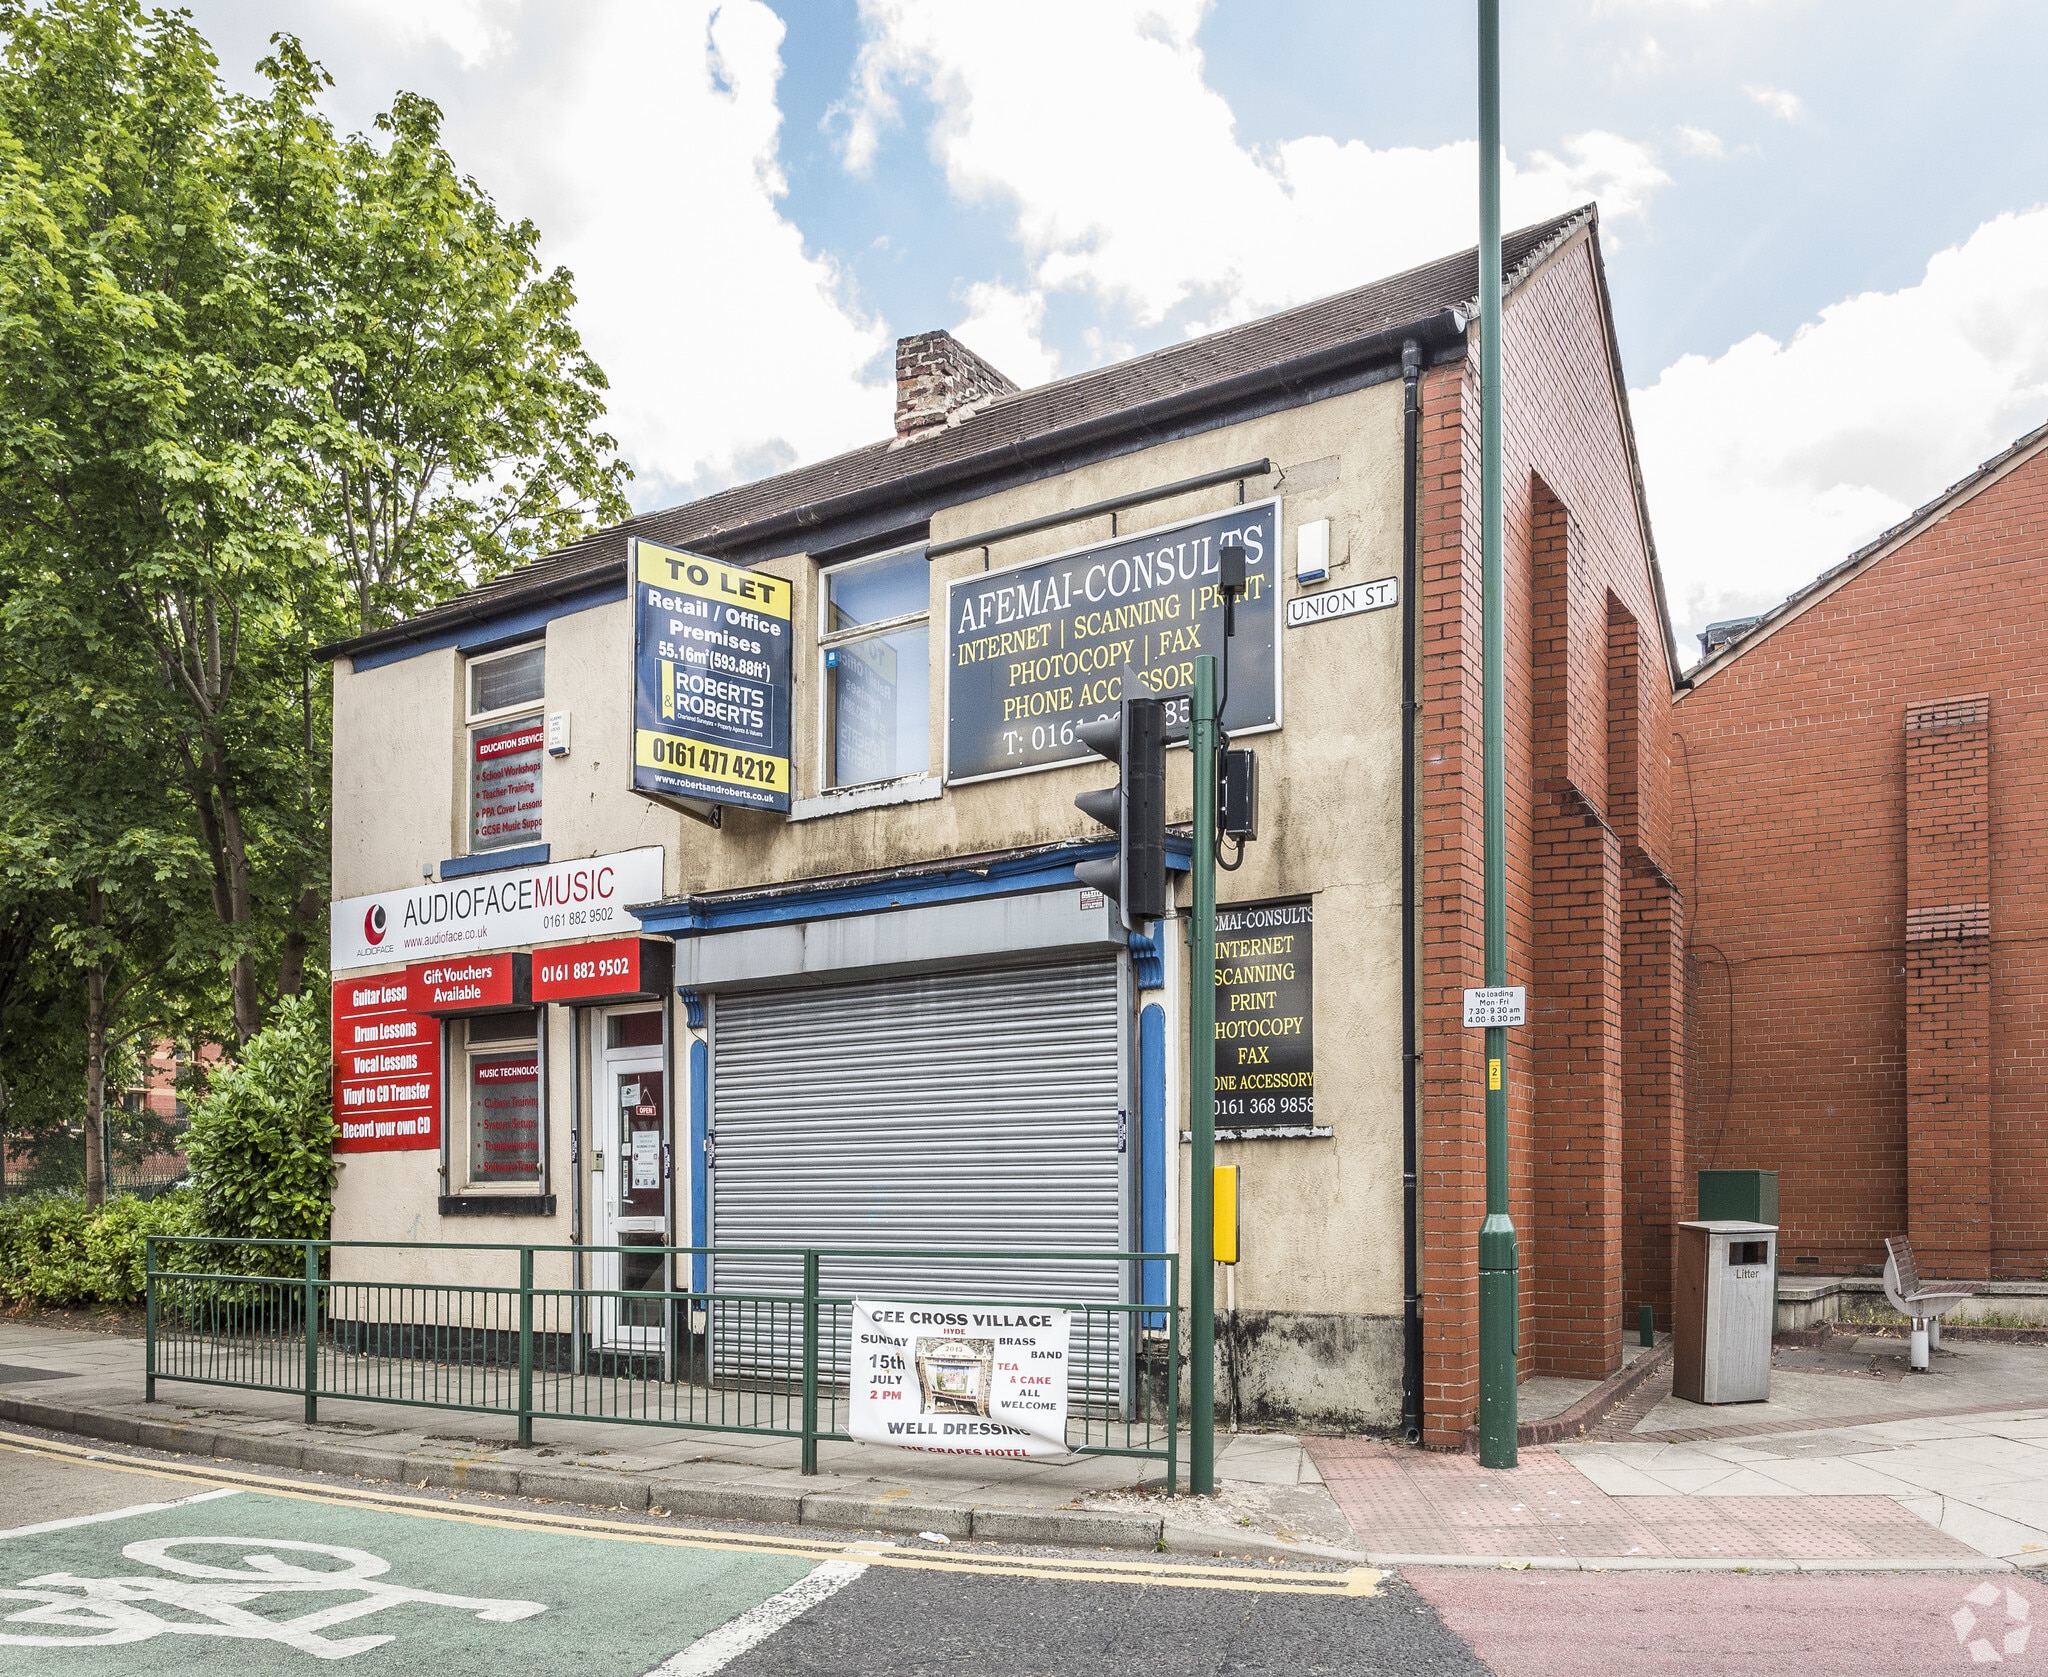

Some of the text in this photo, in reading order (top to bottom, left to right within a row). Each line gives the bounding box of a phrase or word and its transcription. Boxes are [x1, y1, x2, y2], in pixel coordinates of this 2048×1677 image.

[665, 557, 775, 604] TO LET
[648, 589, 708, 618] Retail
[725, 608, 781, 636] Office
[1292, 591, 1356, 621] UNION
[669, 618, 762, 655] Premises
[957, 622, 1052, 666] INTERNET
[1074, 593, 1181, 640] SCANNING
[1009, 639, 1135, 687] PHOTOCOPY
[1159, 623, 1202, 656] FAX
[676, 671, 764, 708] ROBERTS
[664, 692, 764, 729] & ROBERTS
[1003, 686, 1074, 721] PHONE
[479, 738, 517, 755] EDUCATION
[1003, 729, 1024, 755] T:
[653, 738, 776, 784] 0161 477 4212
[481, 762, 541, 781] School Workshops
[481, 782, 535, 800] Teacher Training
[654, 774, 774, 803] www.robertsandroberts.co.uk
[481, 799, 542, 818] PPA Cover Lessons
[481, 818, 542, 836] GCSE Music Suppo
[543, 906, 613, 929] 0161 882 9502
[403, 926, 488, 949] www.audioface.co.uk
[356, 944, 394, 957] AUDIOFACE
[1215, 935, 1295, 960] INTERNET
[423, 964, 492, 985] Gift Vouchers
[541, 957, 629, 983] 0161 882 9502
[1215, 962, 1296, 987] SCANNING
[352, 985, 407, 1007] Guitar Lesso
[433, 985, 481, 1003] Available
[1230, 991, 1277, 1012] PRINT
[1486, 990, 1514, 998] loading
[1215, 1017, 1304, 1039] HOTOCOPY
[1509, 1015, 1521, 1023] pm
[354, 1021, 417, 1043] Drum Lessons
[353, 1053, 418, 1074] Vocal Lessons
[1237, 1046, 1270, 1065] FAX
[479, 1065, 538, 1078] MUSIC TECHNOLOG
[1492, 1067, 1498, 1077] 2
[1215, 1072, 1314, 1091] ONE ACCESSORY
[343, 1082, 430, 1107] Vinyl to CD Transfer
[1215, 1097, 1314, 1115] 0161 368 9858
[342, 1116, 431, 1139] Record your own CD
[484, 1118, 537, 1133] System Setups
[484, 1161, 515, 1173] Software
[1735, 1268, 1760, 1280] Litter
[871, 1310, 1052, 1327] GEE CROSS VILLAGE
[860, 1333, 909, 1347] SUNDAY
[999, 1337, 1036, 1346] BRASS
[869, 1353, 906, 1370] 15th
[1030, 1351, 1063, 1359] BAND
[997, 1362, 1019, 1371] TEA
[870, 1374, 903, 1385] JULY
[1009, 1375, 1052, 1385] & CAKE
[870, 1390, 902, 1400] 2 PM
[1018, 1389, 1041, 1397] ALL
[1000, 1400, 1057, 1410] WELCOME
[887, 1421, 938, 1435] WELL
[985, 1448, 1031, 1457] HOTEL
